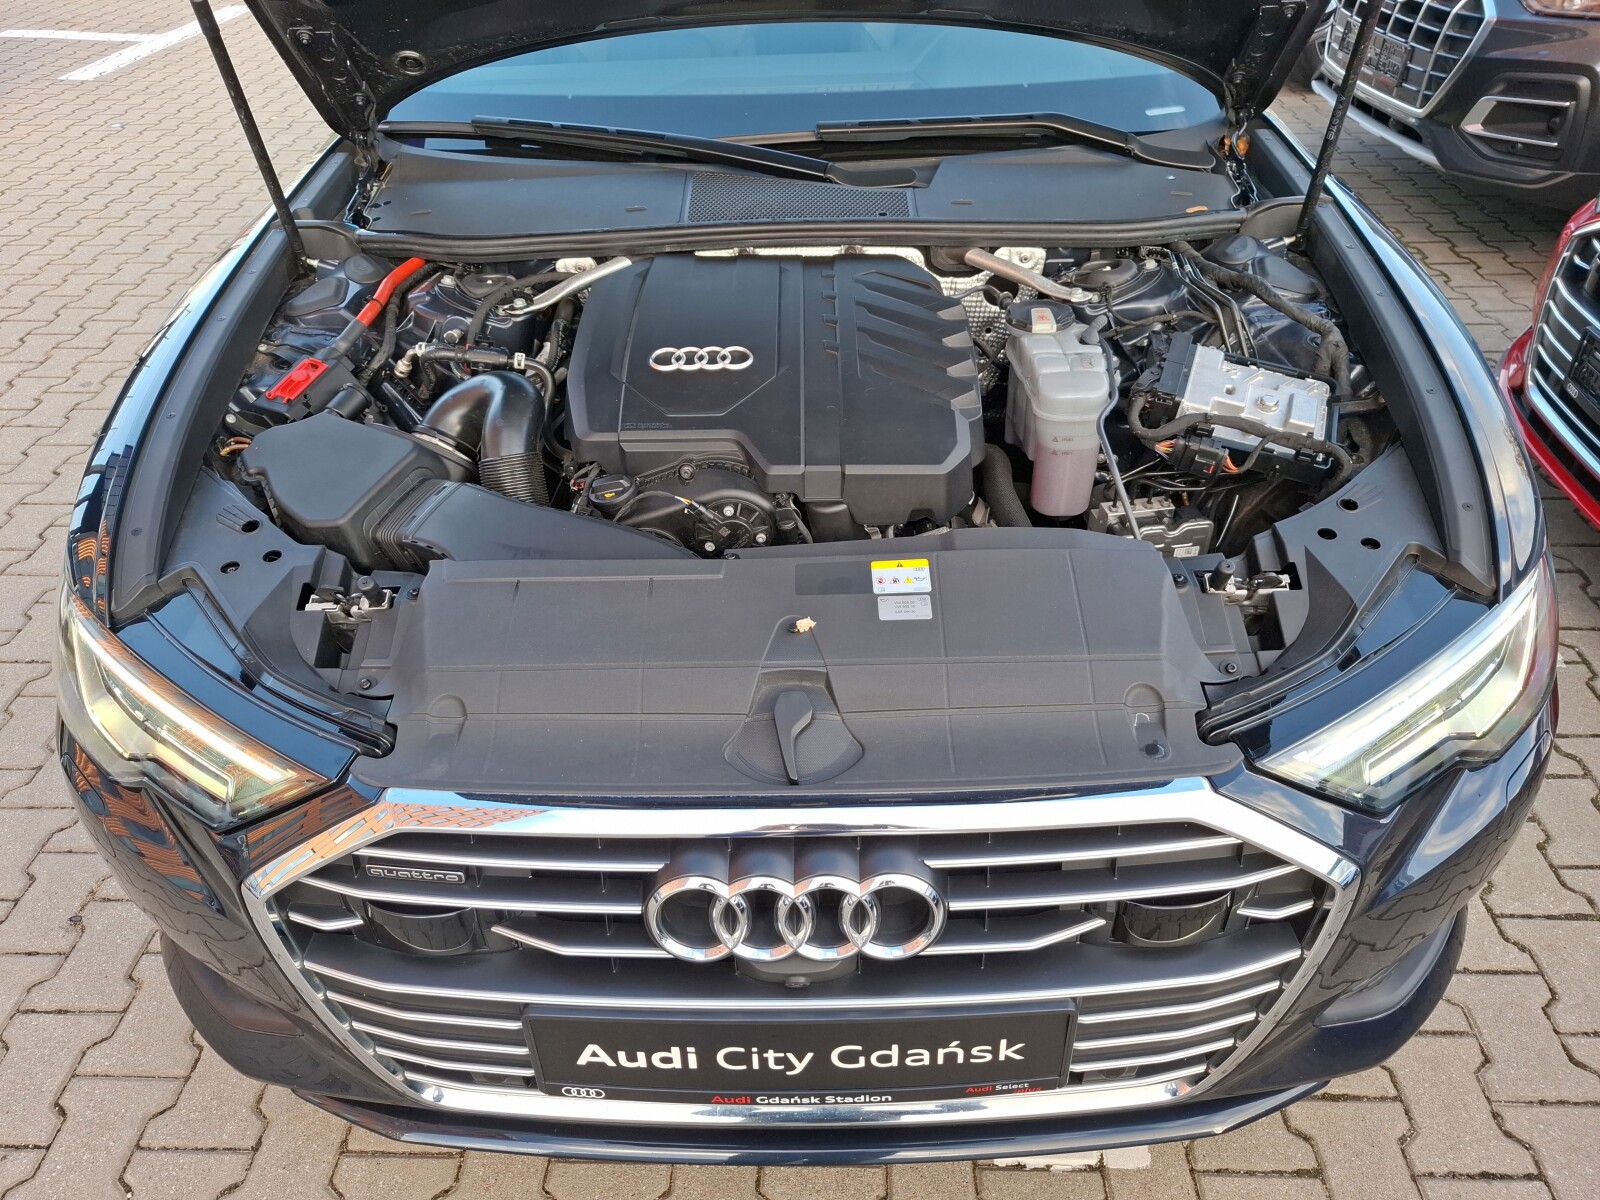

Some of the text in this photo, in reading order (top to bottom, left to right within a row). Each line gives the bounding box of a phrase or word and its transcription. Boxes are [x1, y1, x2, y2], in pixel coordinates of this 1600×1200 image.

[370, 868, 459, 882] quattro
[576, 1038, 1026, 1076] Audi City Gdańsk
[965, 1083, 1030, 1094] Audi Select
[711, 1095, 892, 1105] Audi Gdańsk Stadion
